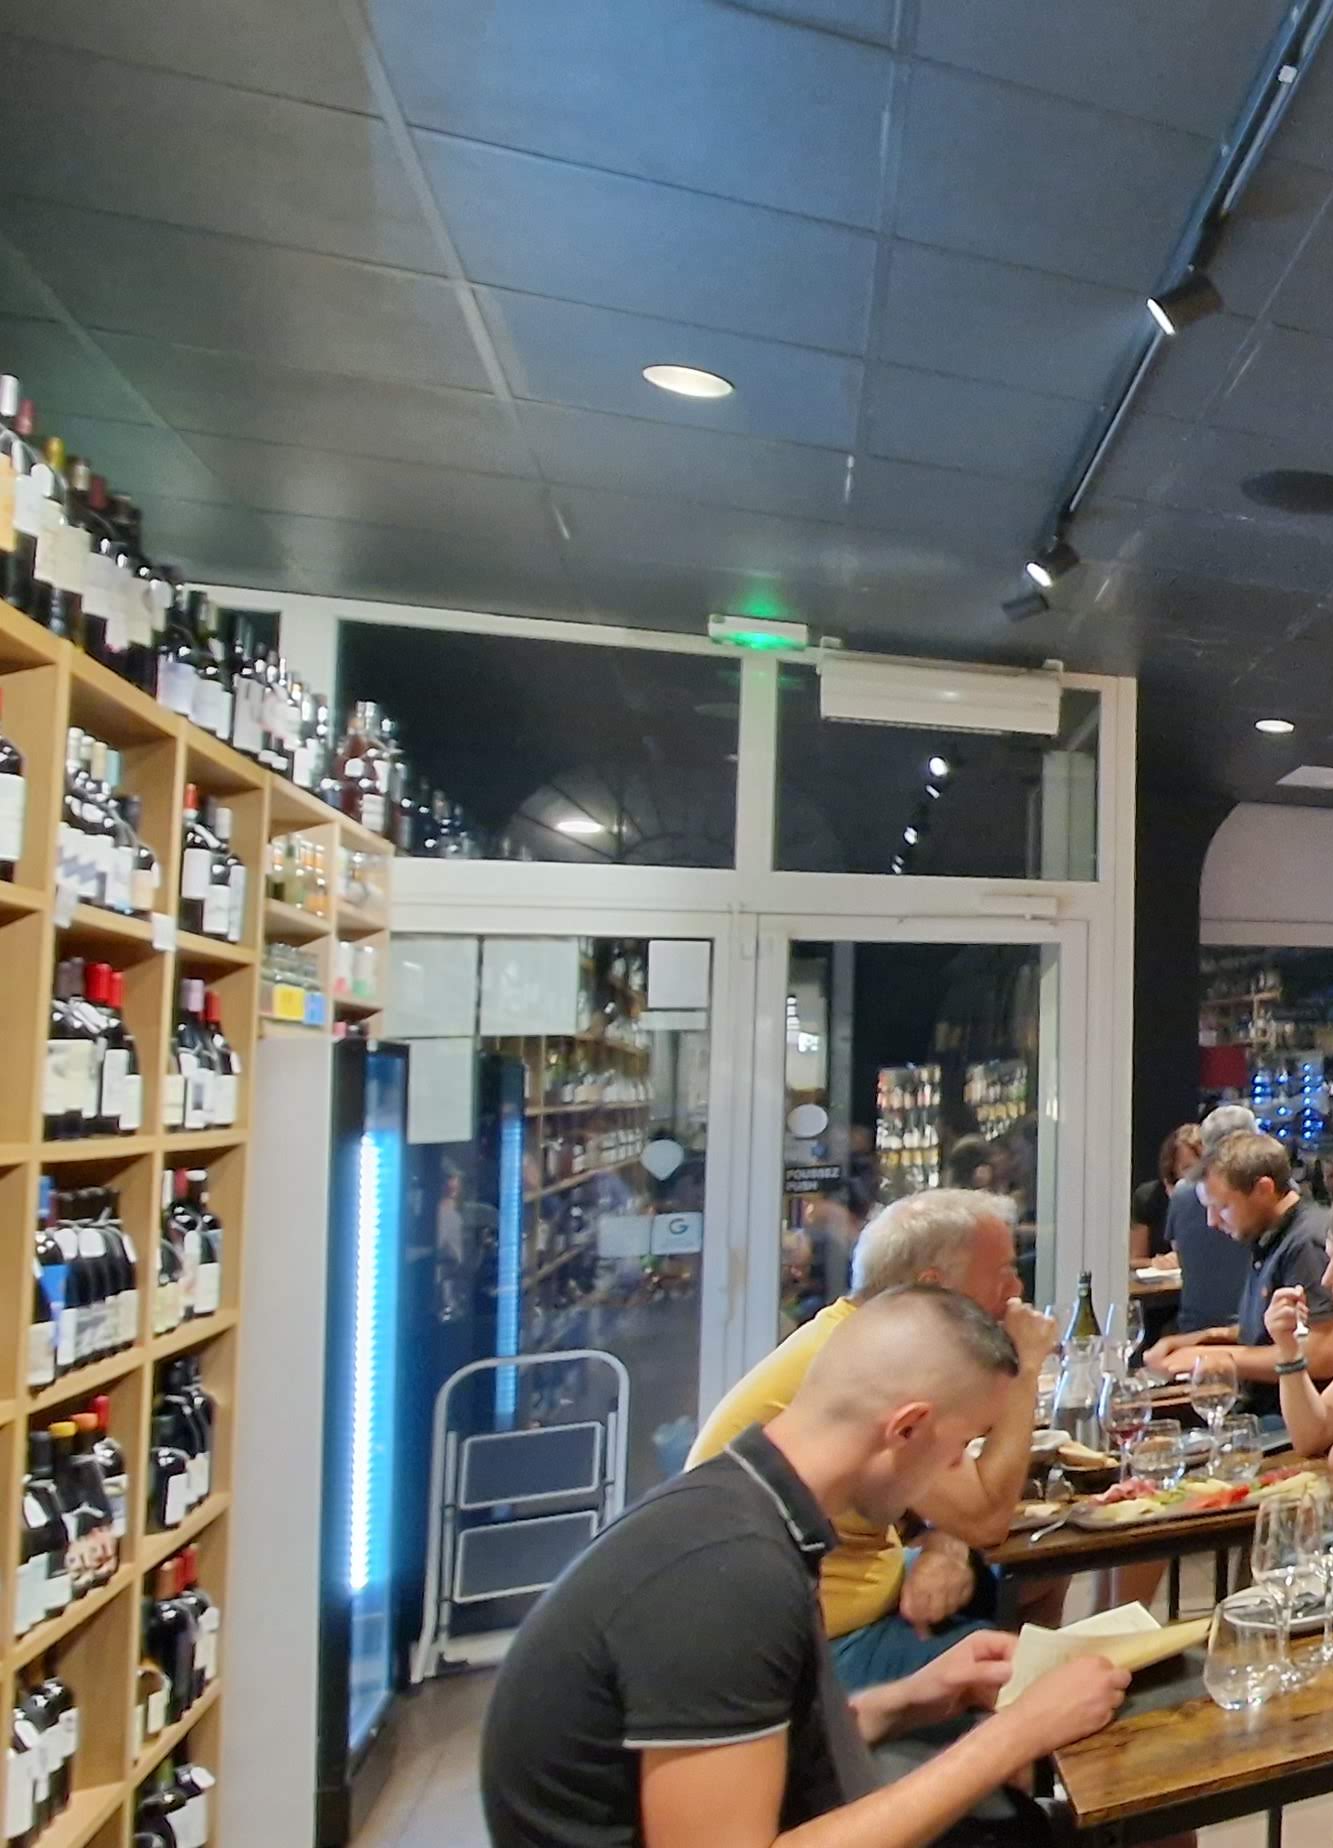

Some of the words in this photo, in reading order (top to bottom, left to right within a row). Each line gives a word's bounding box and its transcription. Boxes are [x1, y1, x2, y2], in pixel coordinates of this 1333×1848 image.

[785, 1167, 840, 1180] POUSSEZ
[785, 1180, 818, 1191] PUSH
[669, 1217, 689, 1235] G
